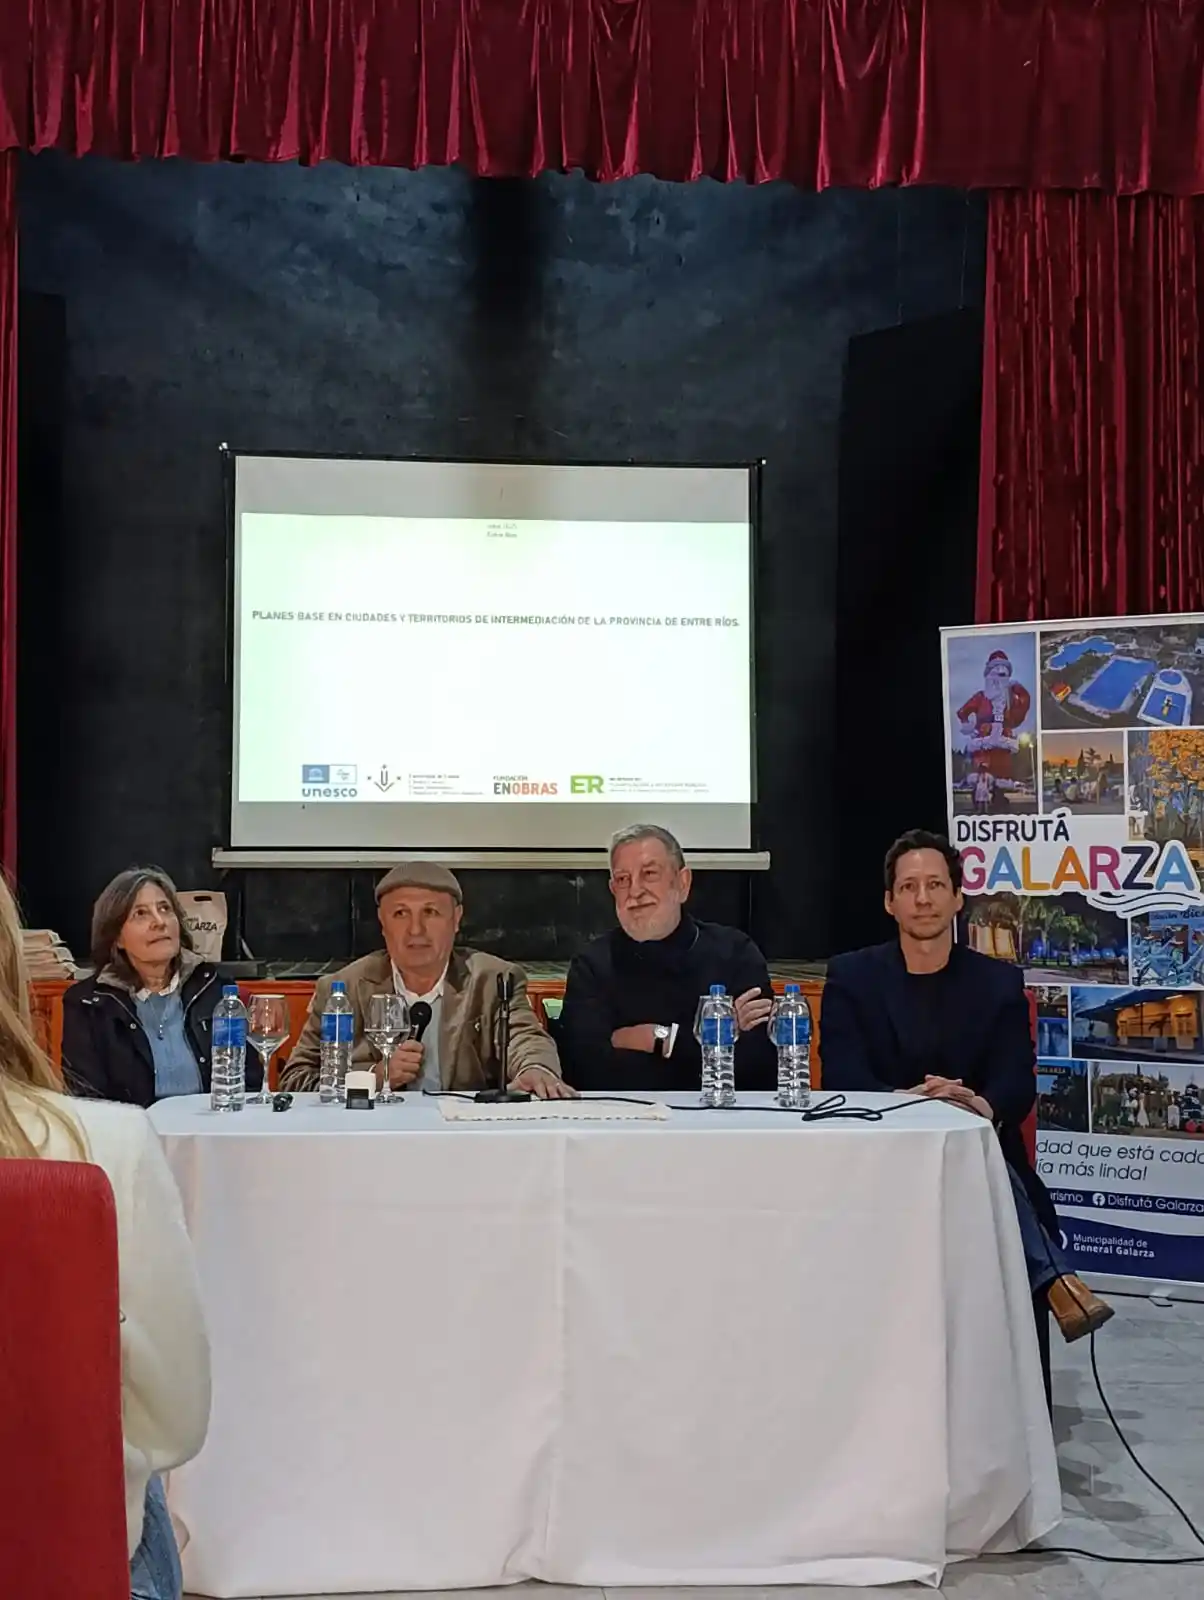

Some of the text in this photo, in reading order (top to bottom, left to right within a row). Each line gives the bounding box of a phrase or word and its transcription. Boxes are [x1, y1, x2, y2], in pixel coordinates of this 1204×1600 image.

[252, 610, 294, 620] PLANES
[298, 612, 325, 621] BASE
[328, 612, 342, 622] EN
[345, 612, 397, 622] CIUDADES
[399, 613, 406, 623] Y
[408, 613, 472, 623] TERRITORIOS
[475, 615, 489, 624] DE
[491, 613, 575, 625] INTERMEDIACIÓN
[577, 616, 590, 625] DE
[593, 616, 606, 626] LA
[609, 616, 661, 626] PROVINCIA
[665, 617, 678, 627] DE
[681, 617, 712, 627] ENTRE
[302, 787, 358, 798] unesco
[493, 782, 558, 795] ENOBRAS
[570, 775, 605, 794] ER
[957, 813, 1070, 842] DISFRUTÁ
[961, 845, 1194, 890] GALARZA
[1078, 1143, 1112, 1159] que
[1117, 1142, 1155, 1161] está
[1037, 1158, 1148, 1181] ía más linda!
[1108, 1194, 1152, 1209] Disfrutá
[1155, 1198, 1204, 1213] Galarza
[1073, 1234, 1148, 1248] Municipalidad de
[1073, 1243, 1155, 1259] General Galarza
